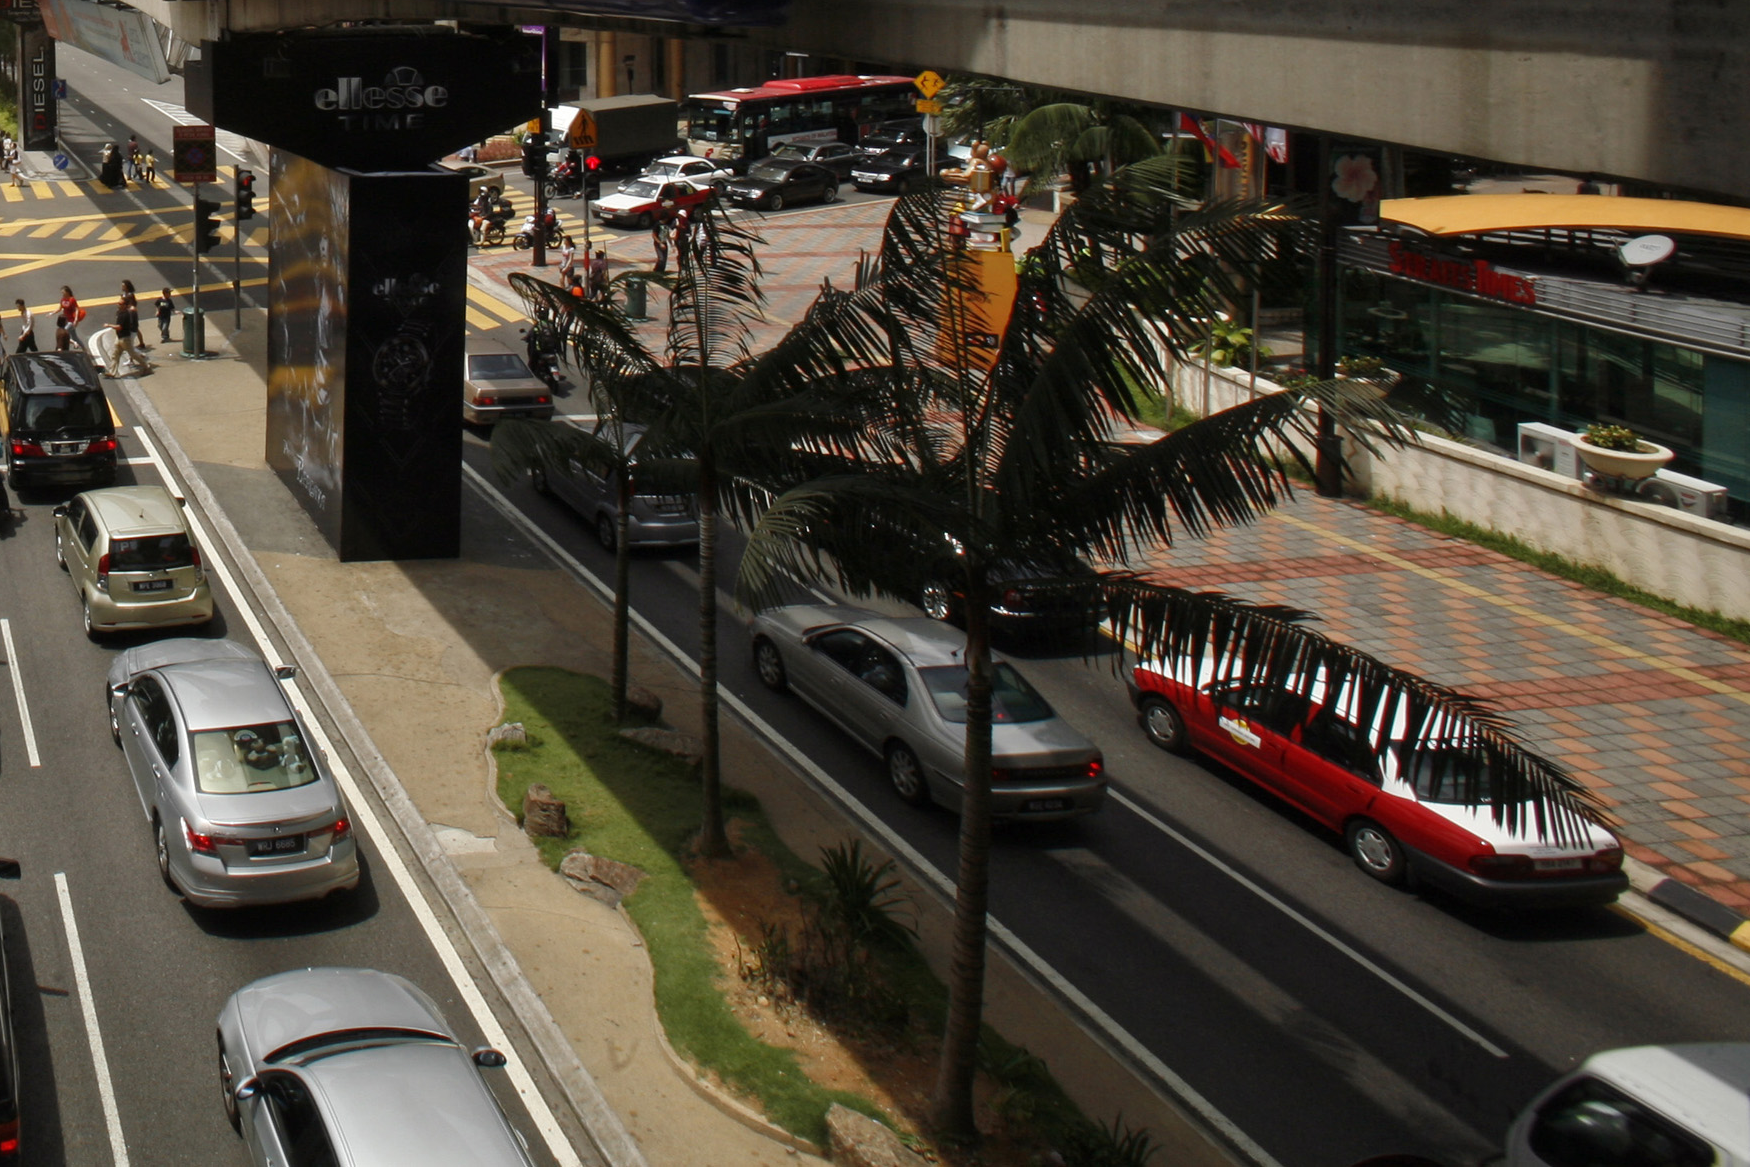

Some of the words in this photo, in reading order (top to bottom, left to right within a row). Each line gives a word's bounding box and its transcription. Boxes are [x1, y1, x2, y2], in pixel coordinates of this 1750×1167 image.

[33, 45, 46, 130] DIESEL
[314, 76, 448, 110] ellesse
[339, 113, 424, 131] TIME
[257, 840, 273, 851] WRJ
